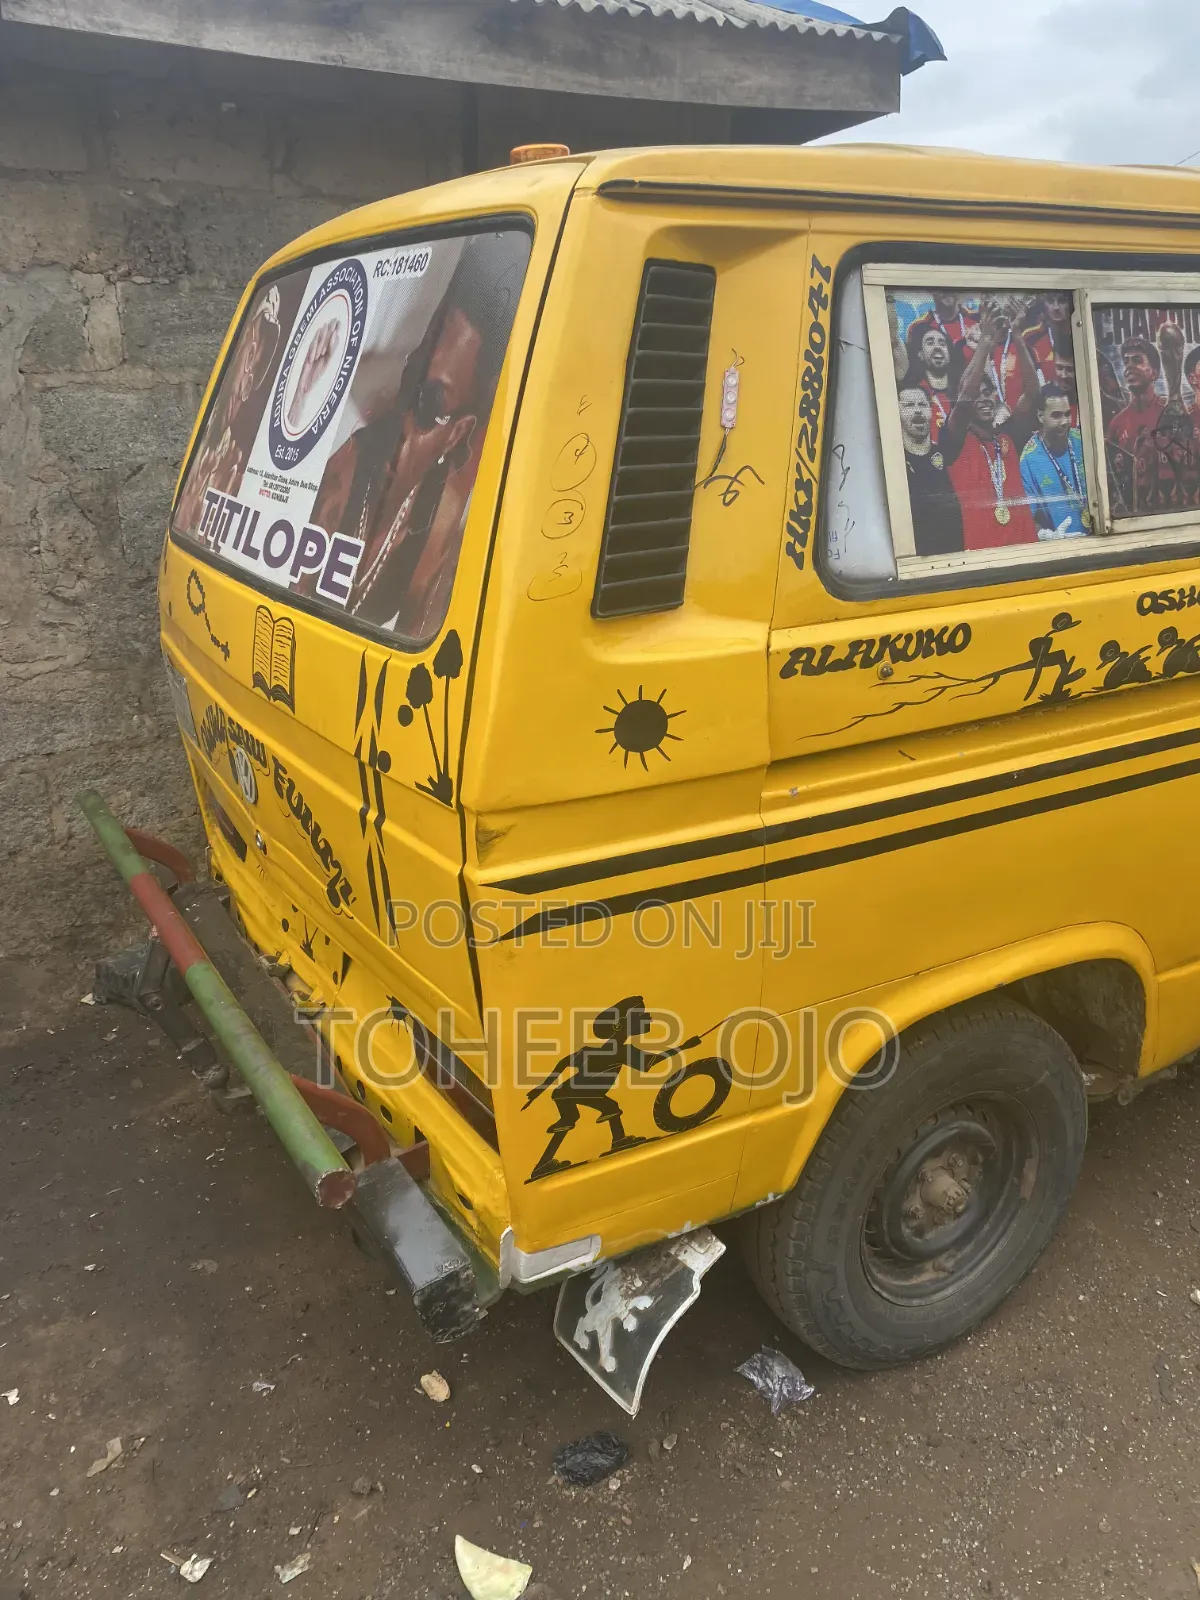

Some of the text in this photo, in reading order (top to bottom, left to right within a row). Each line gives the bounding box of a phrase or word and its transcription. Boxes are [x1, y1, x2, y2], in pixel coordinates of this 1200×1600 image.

[372, 252, 429, 279] RC:181460
[273, 266, 364, 435] ADURA GBEMI ASSOCIATION OF NIGERIA
[199, 490, 363, 601] TITILOPE
[1135, 584, 1200, 617] OSH
